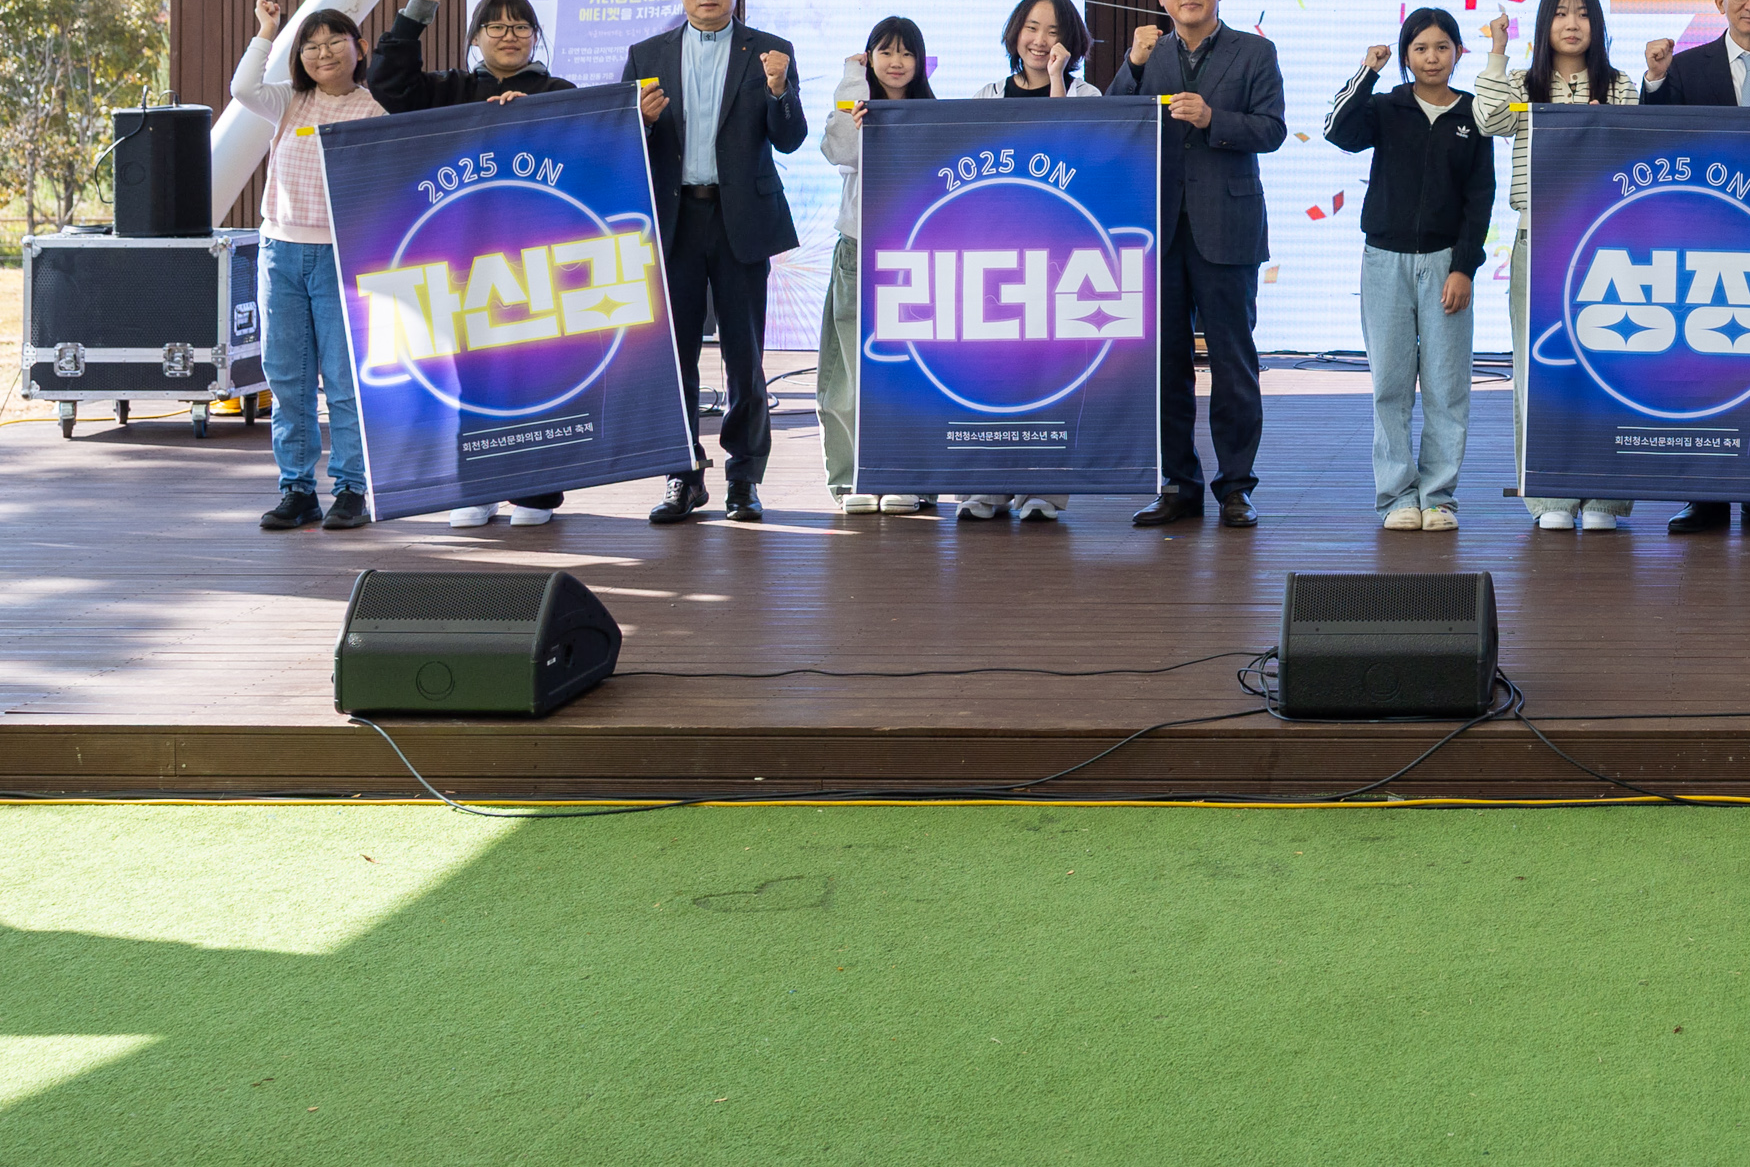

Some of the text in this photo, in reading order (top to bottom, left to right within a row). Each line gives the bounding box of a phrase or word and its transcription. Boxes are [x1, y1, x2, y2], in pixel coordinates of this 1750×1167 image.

[579, 3, 688, 21] 에티켓을 지켜주세
[418, 151, 564, 204] 2025 ON
[937, 149, 1078, 193] 2025 ON
[1612, 156, 1692, 197] 2025
[356, 231, 655, 368] 자신감
[874, 248, 1146, 343] 리더십
[462, 421, 594, 452] 회천청소년문화의집 청소년 축제
[946, 431, 1068, 442] 회천청소년문화의집 청소년 축제
[1614, 435, 1741, 449] 회천청소년문화의집 청소년 축제
